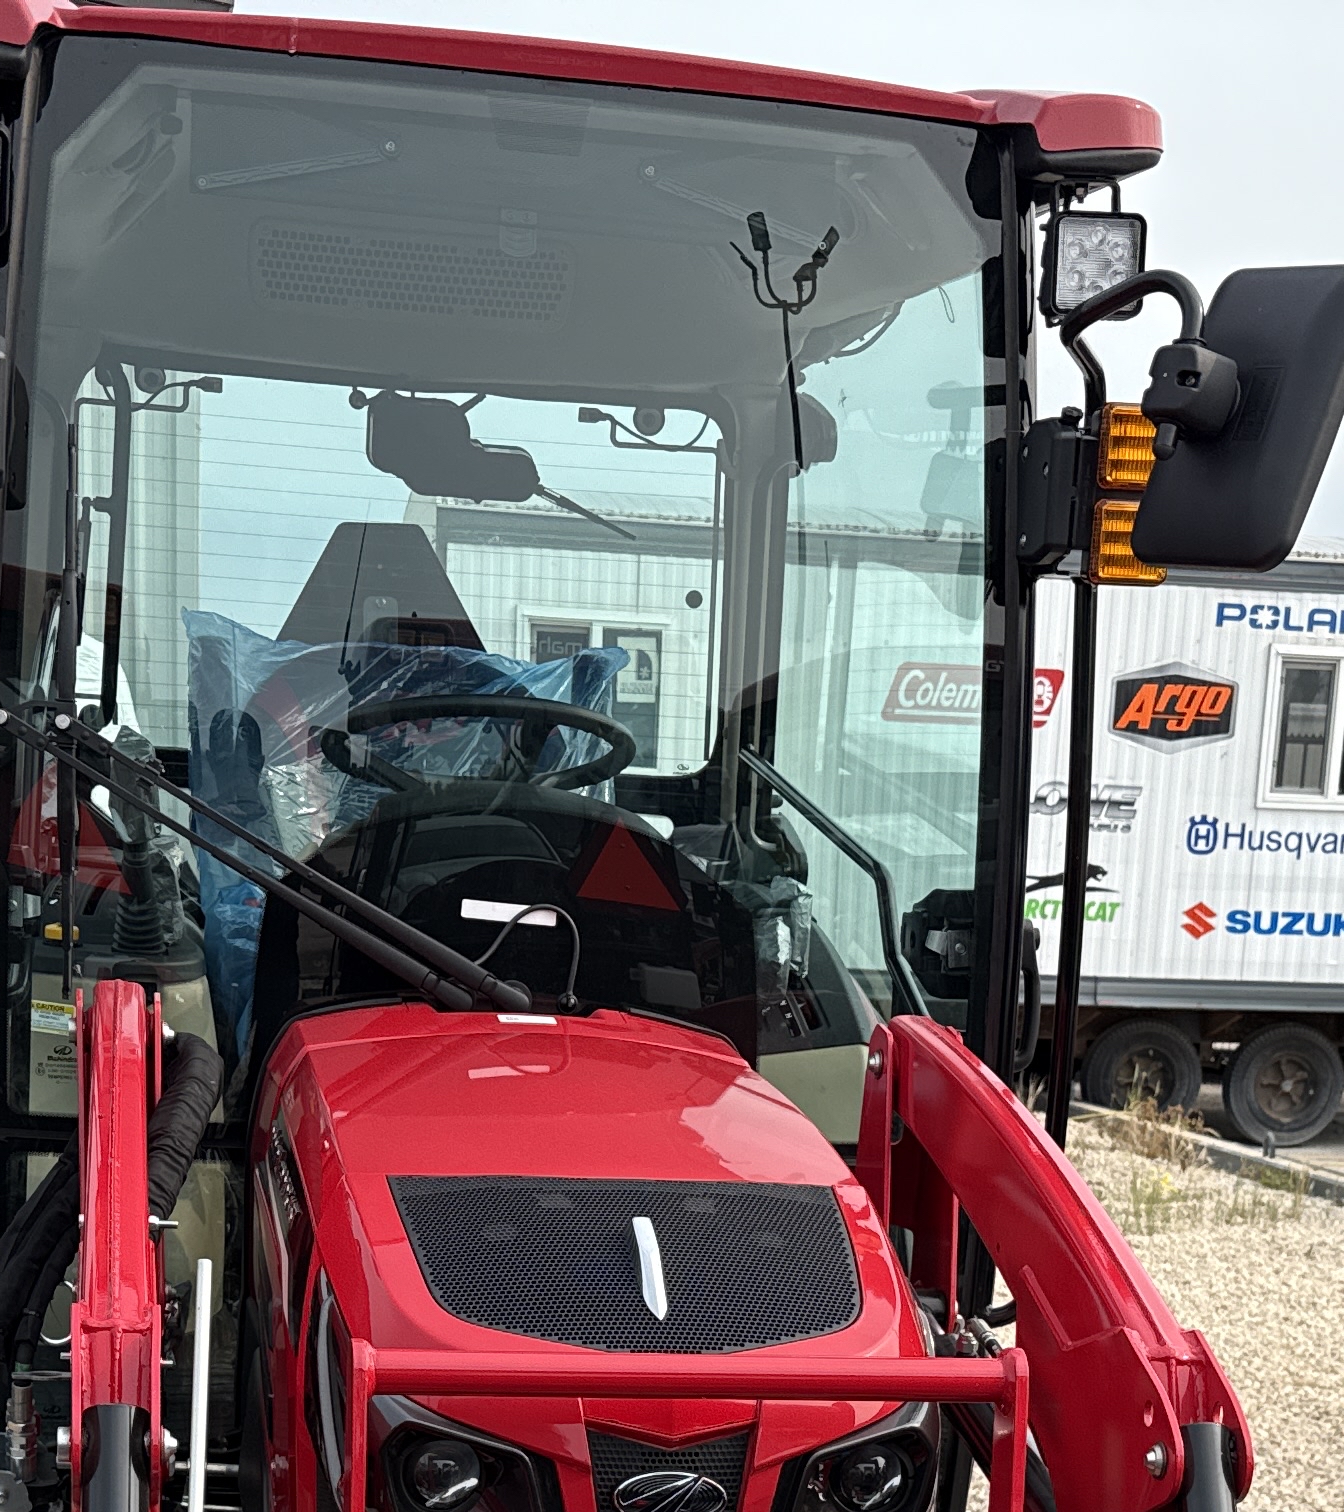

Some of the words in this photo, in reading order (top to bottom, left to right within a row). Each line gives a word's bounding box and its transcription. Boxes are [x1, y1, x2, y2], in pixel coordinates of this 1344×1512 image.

[897, 669, 982, 708] Colem
[1115, 683, 1232, 732] Argo
[1084, 901, 1120, 923] CAT
